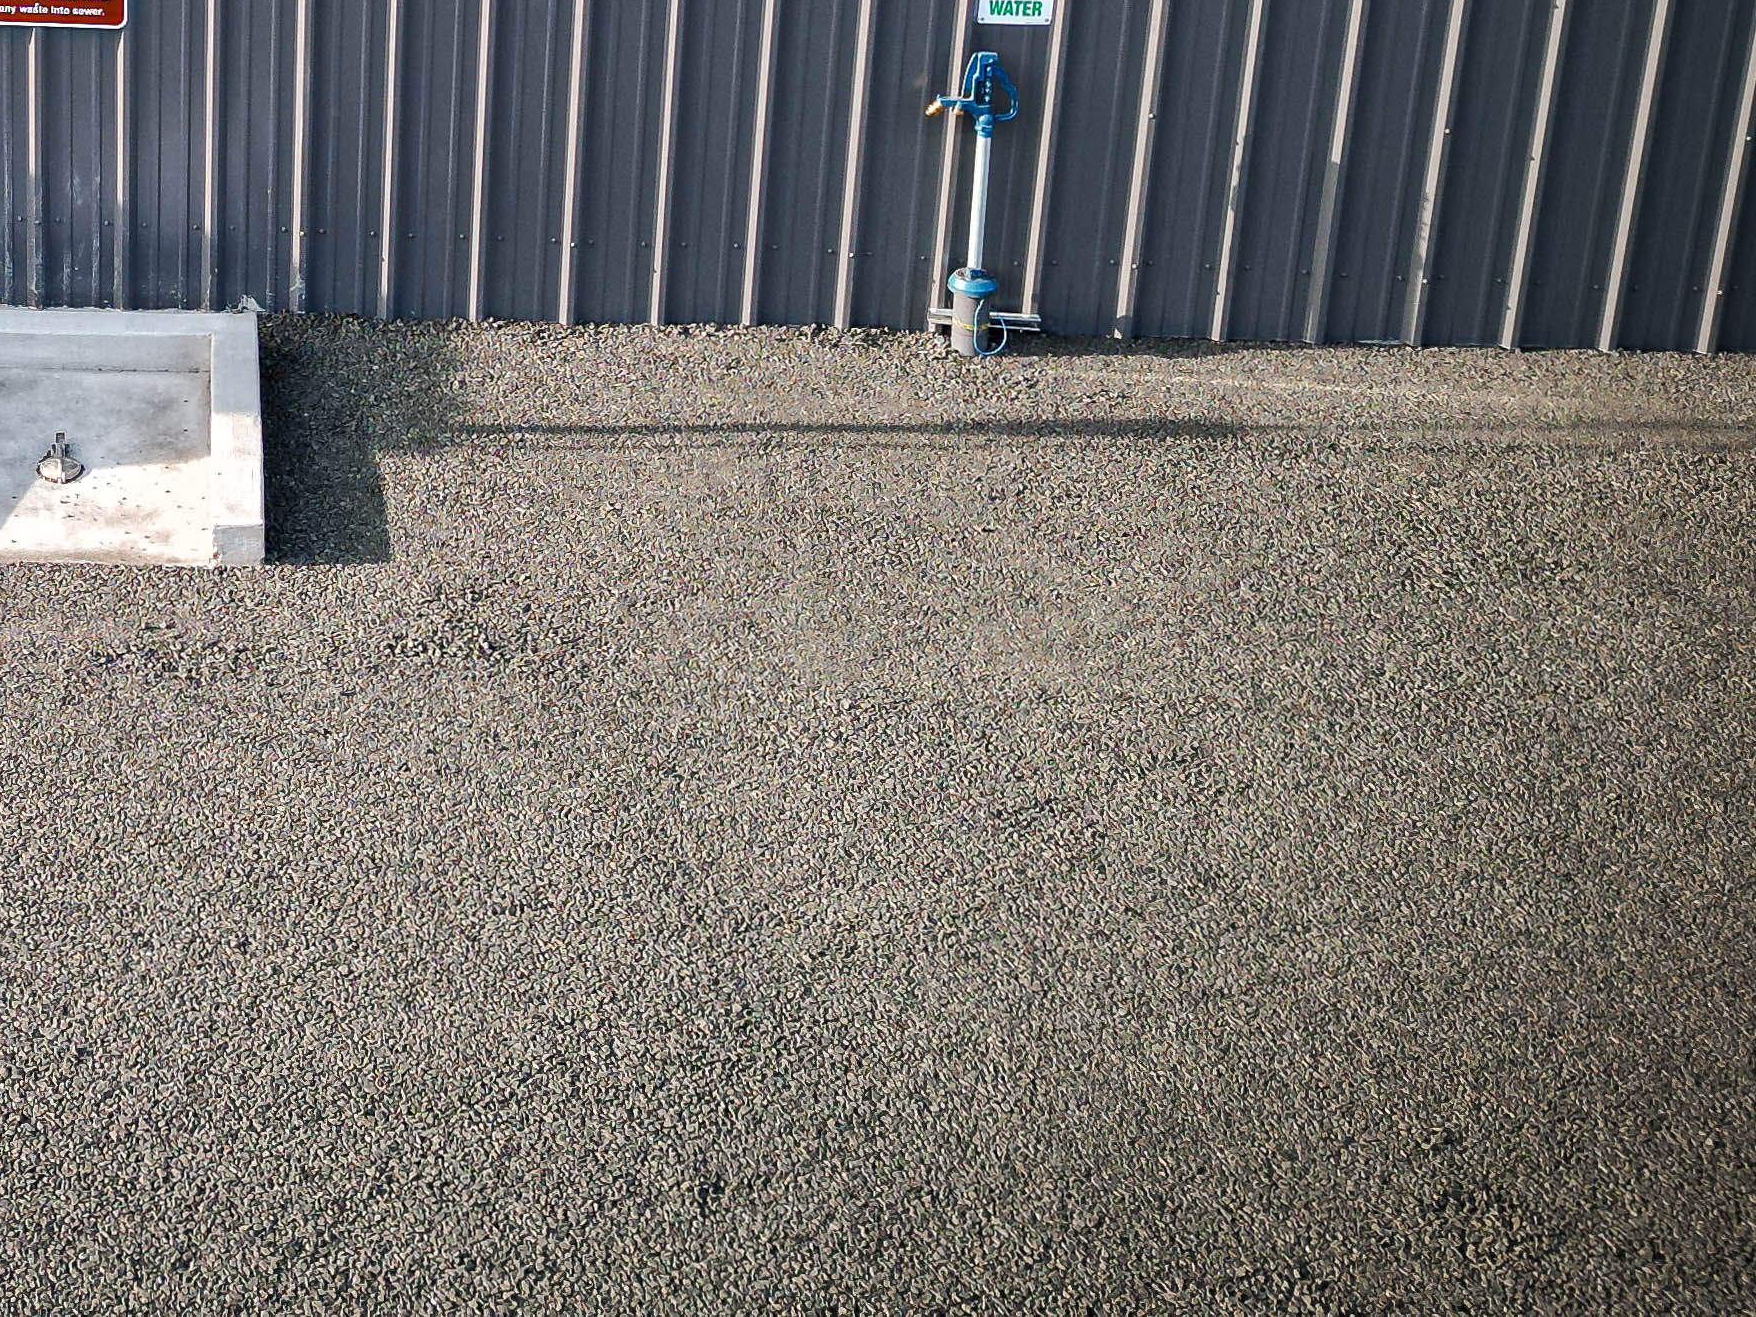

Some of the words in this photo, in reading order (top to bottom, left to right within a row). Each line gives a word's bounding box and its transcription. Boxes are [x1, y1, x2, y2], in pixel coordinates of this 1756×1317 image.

[0, 5, 16, 14] any
[19, 3, 48, 14] waste
[51, 5, 70, 15] into
[72, 8, 105, 16] sewer.
[989, 0, 1042, 16] WATER
